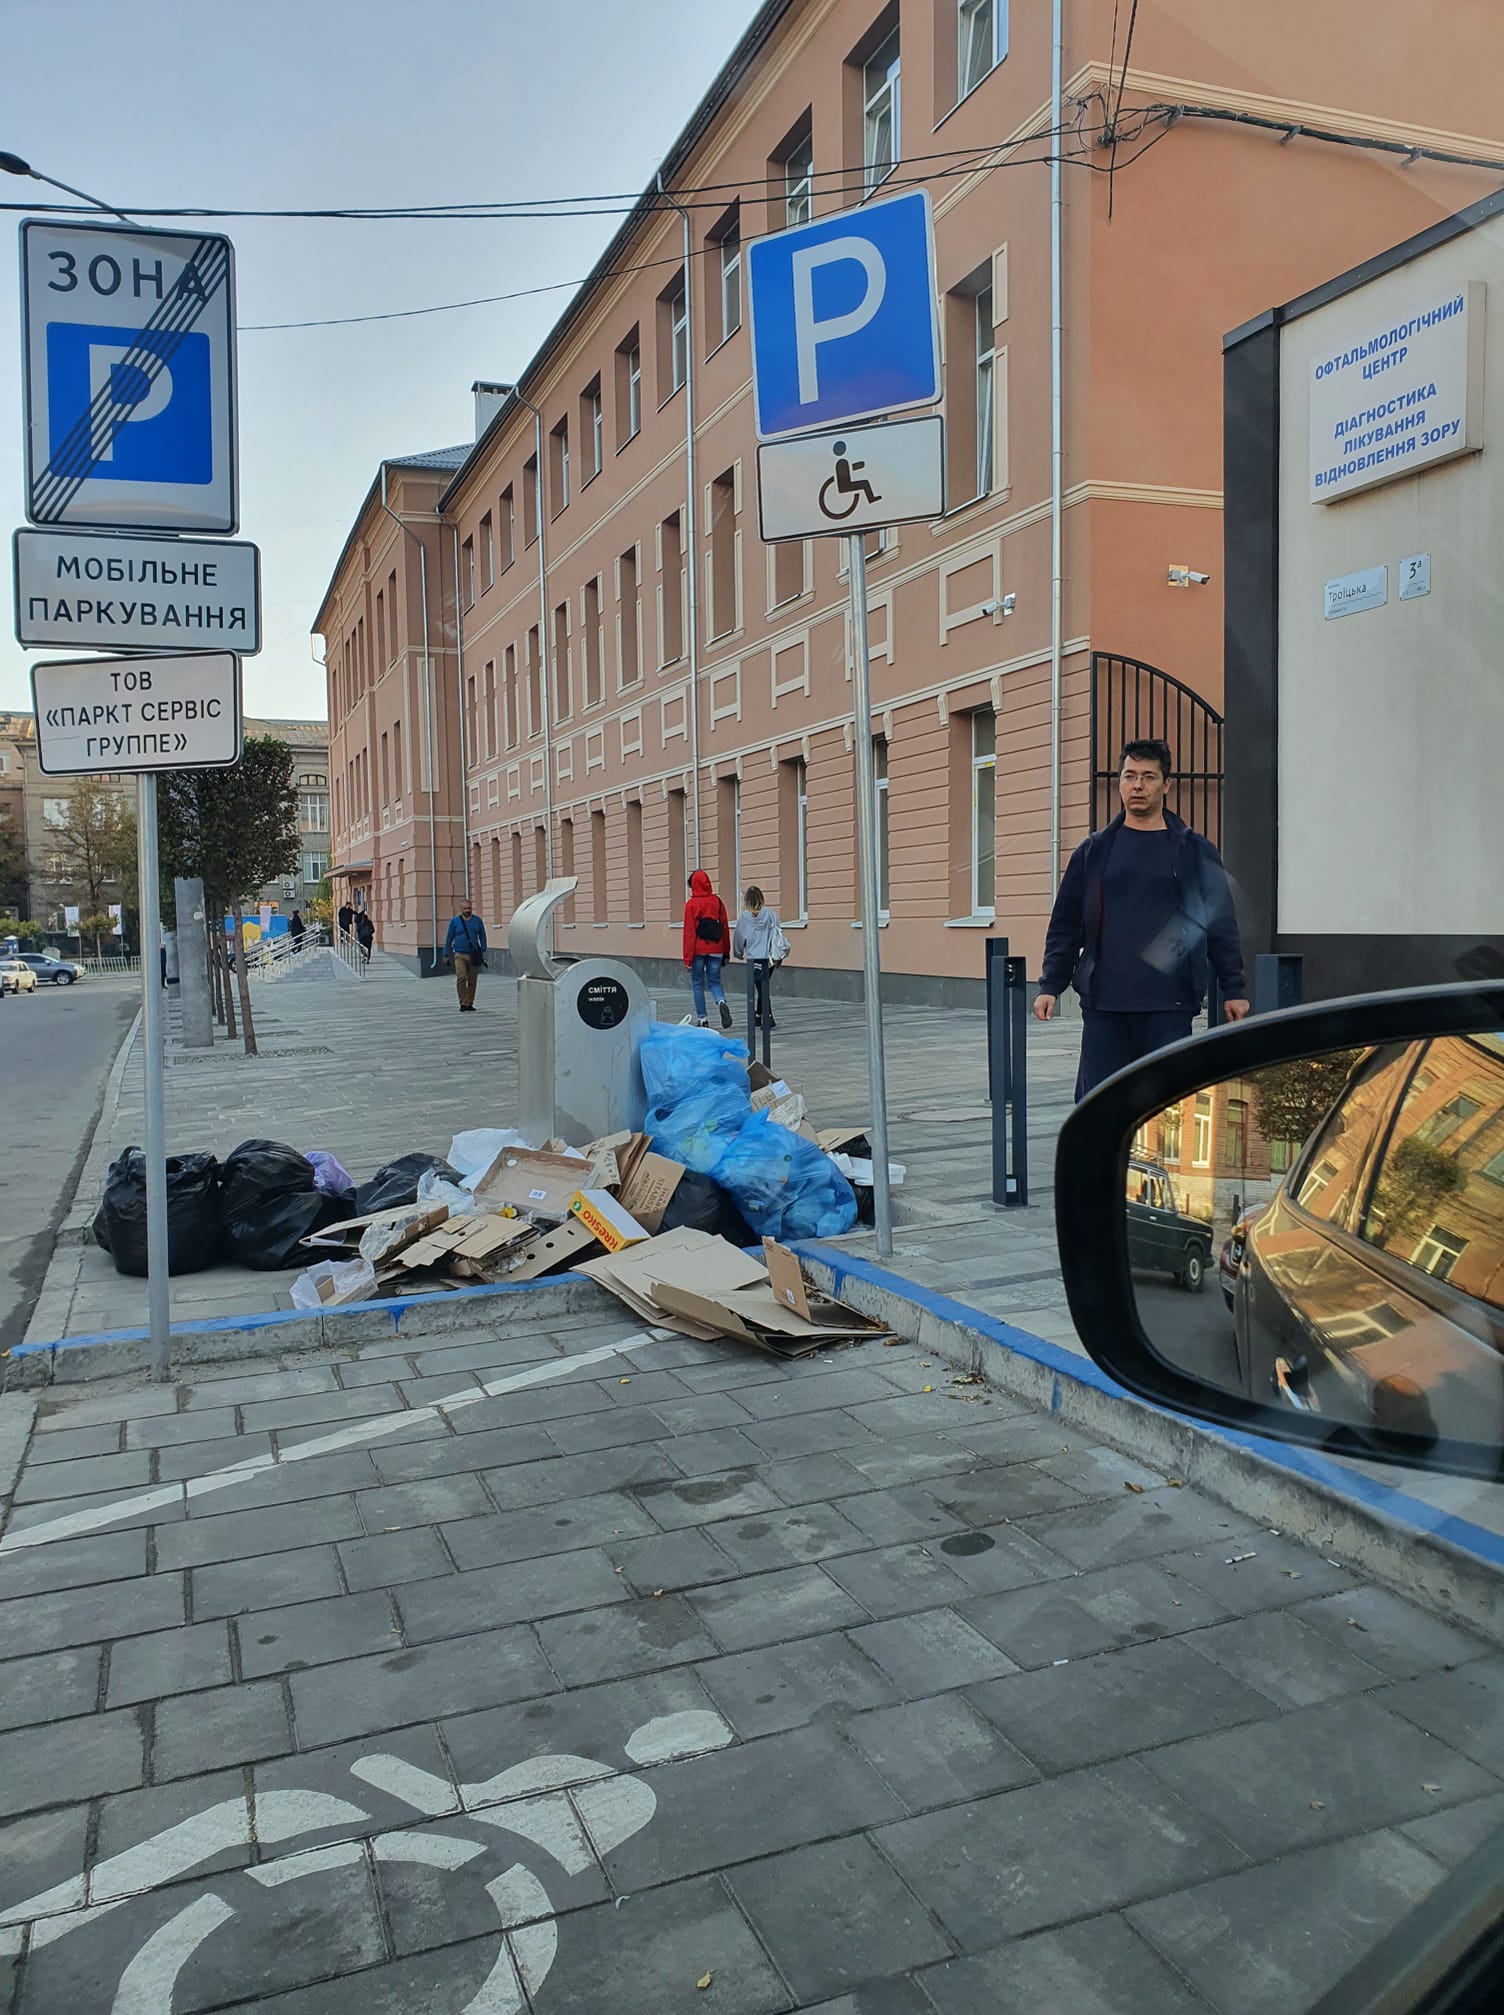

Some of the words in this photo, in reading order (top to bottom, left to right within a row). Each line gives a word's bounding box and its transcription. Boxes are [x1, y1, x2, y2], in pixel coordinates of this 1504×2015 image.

[47, 250, 207, 304] ЗОНА
[792, 236, 887, 406] P
[1315, 294, 1464, 380] ОФТАЛЬМОЛОГІЧНИЙ
[1362, 347, 1408, 381] ЦЕНТР
[1334, 382, 1437, 439] ДІАГНОСТИКА
[1343, 410, 1426, 455] ЛІКУВАННЯ
[1315, 437, 1416, 487] ВІДНОВЛЕННЯ
[1421, 419, 1460, 446] ЗОРУ
[56, 556, 217, 587] МОБІЛЬНЕ
[1328, 584, 1367, 603] Троїцька
[29, 597, 246, 630] ПАРКУВАННЯ
[110, 671, 152, 692] ТОВ
[46, 703, 132, 727] «ПАРКТ
[141, 699, 221, 722] СЕРВІС
[87, 733, 187, 757] ГРУППЕ»
